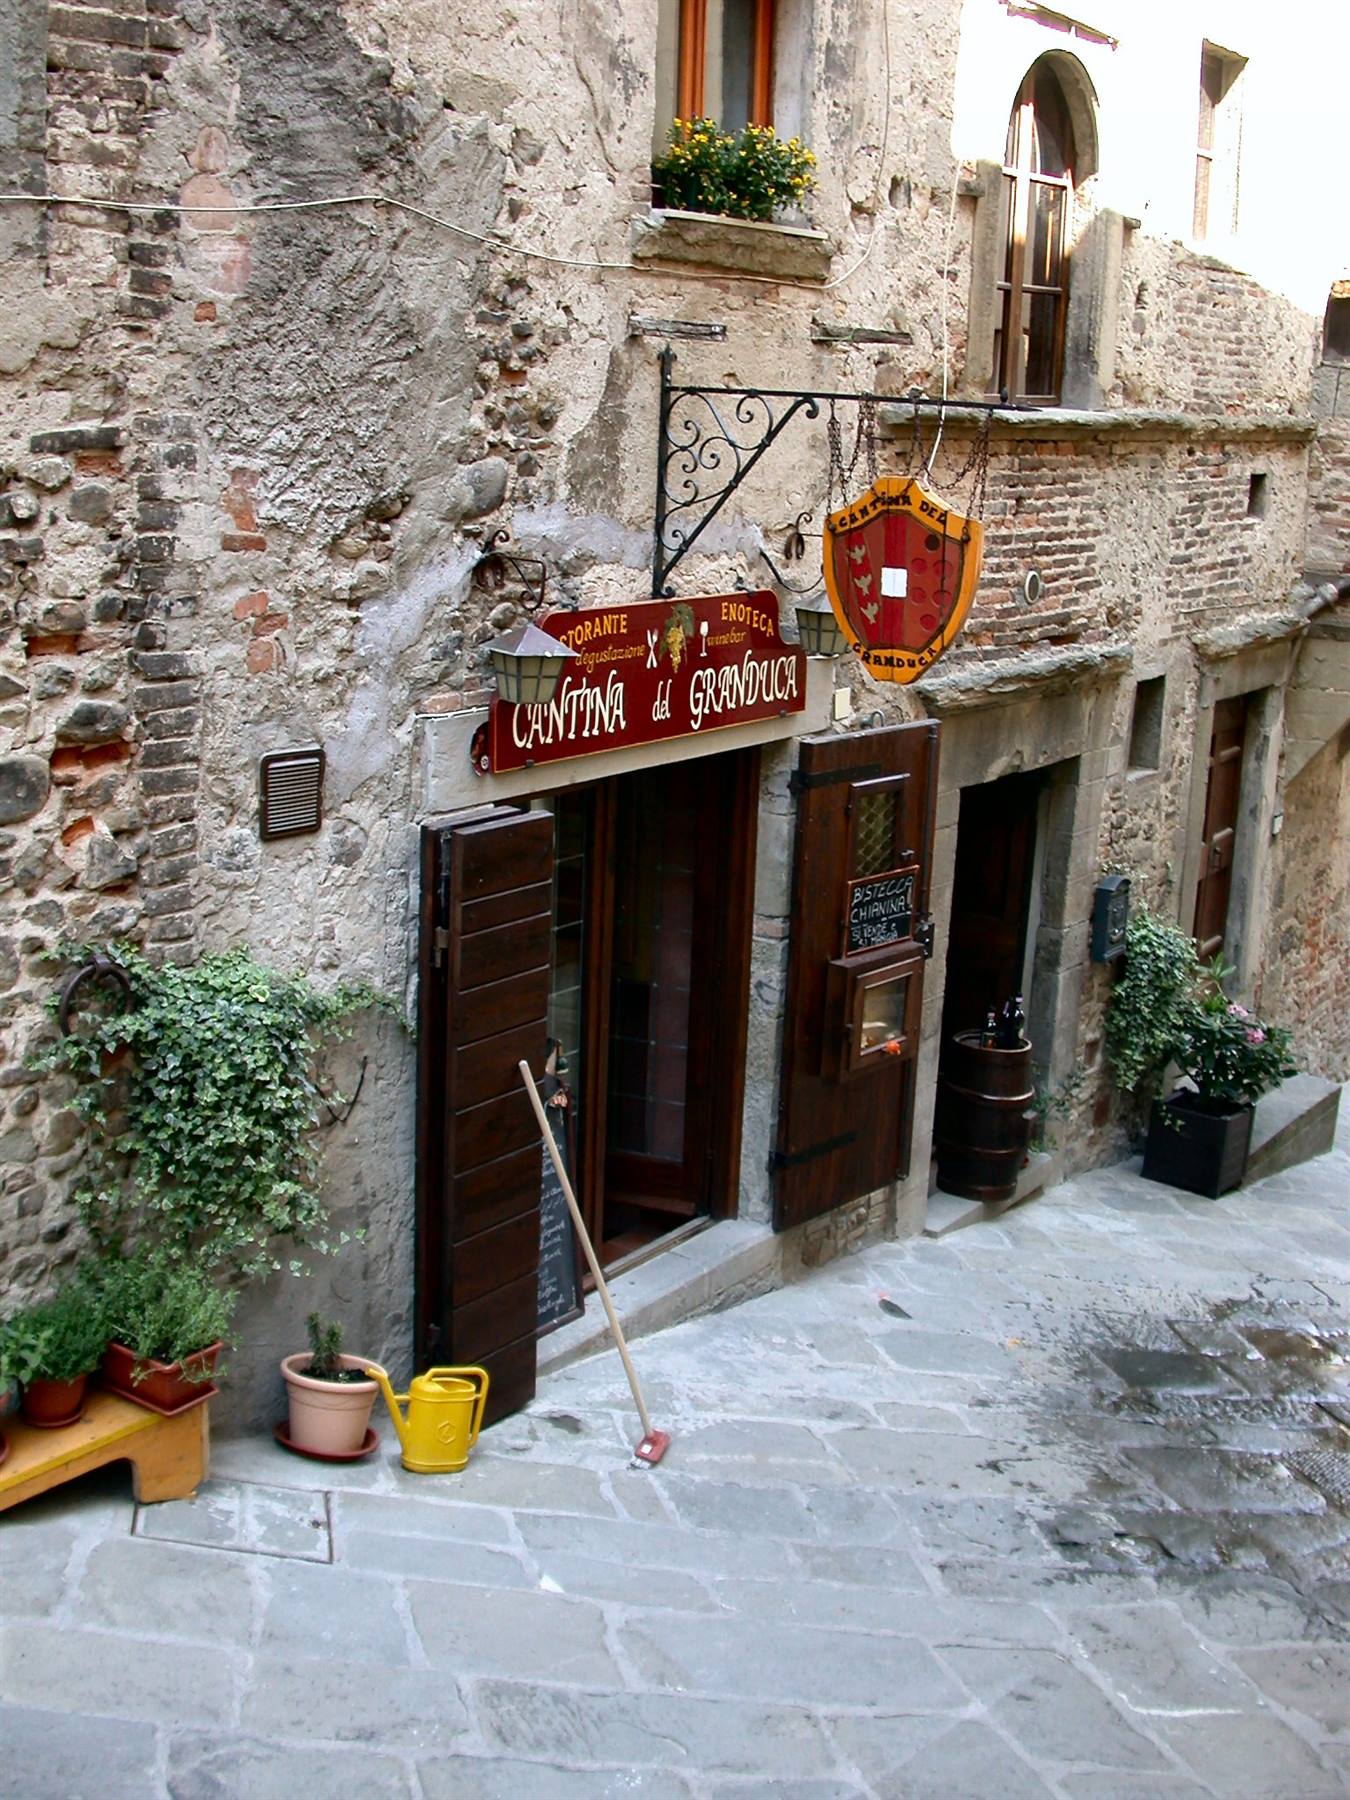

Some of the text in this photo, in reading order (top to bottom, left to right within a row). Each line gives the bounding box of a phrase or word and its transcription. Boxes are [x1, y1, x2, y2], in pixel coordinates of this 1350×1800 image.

[839, 491, 949, 528] CANTINA DEL
[721, 602, 775, 637] ENOTECA
[575, 644, 646, 674] degustazione
[853, 642, 937, 668] GRANDUCA
[513, 649, 798, 749] CANTINA del GRANDUCA
[851, 876, 913, 907] BISTECCA
